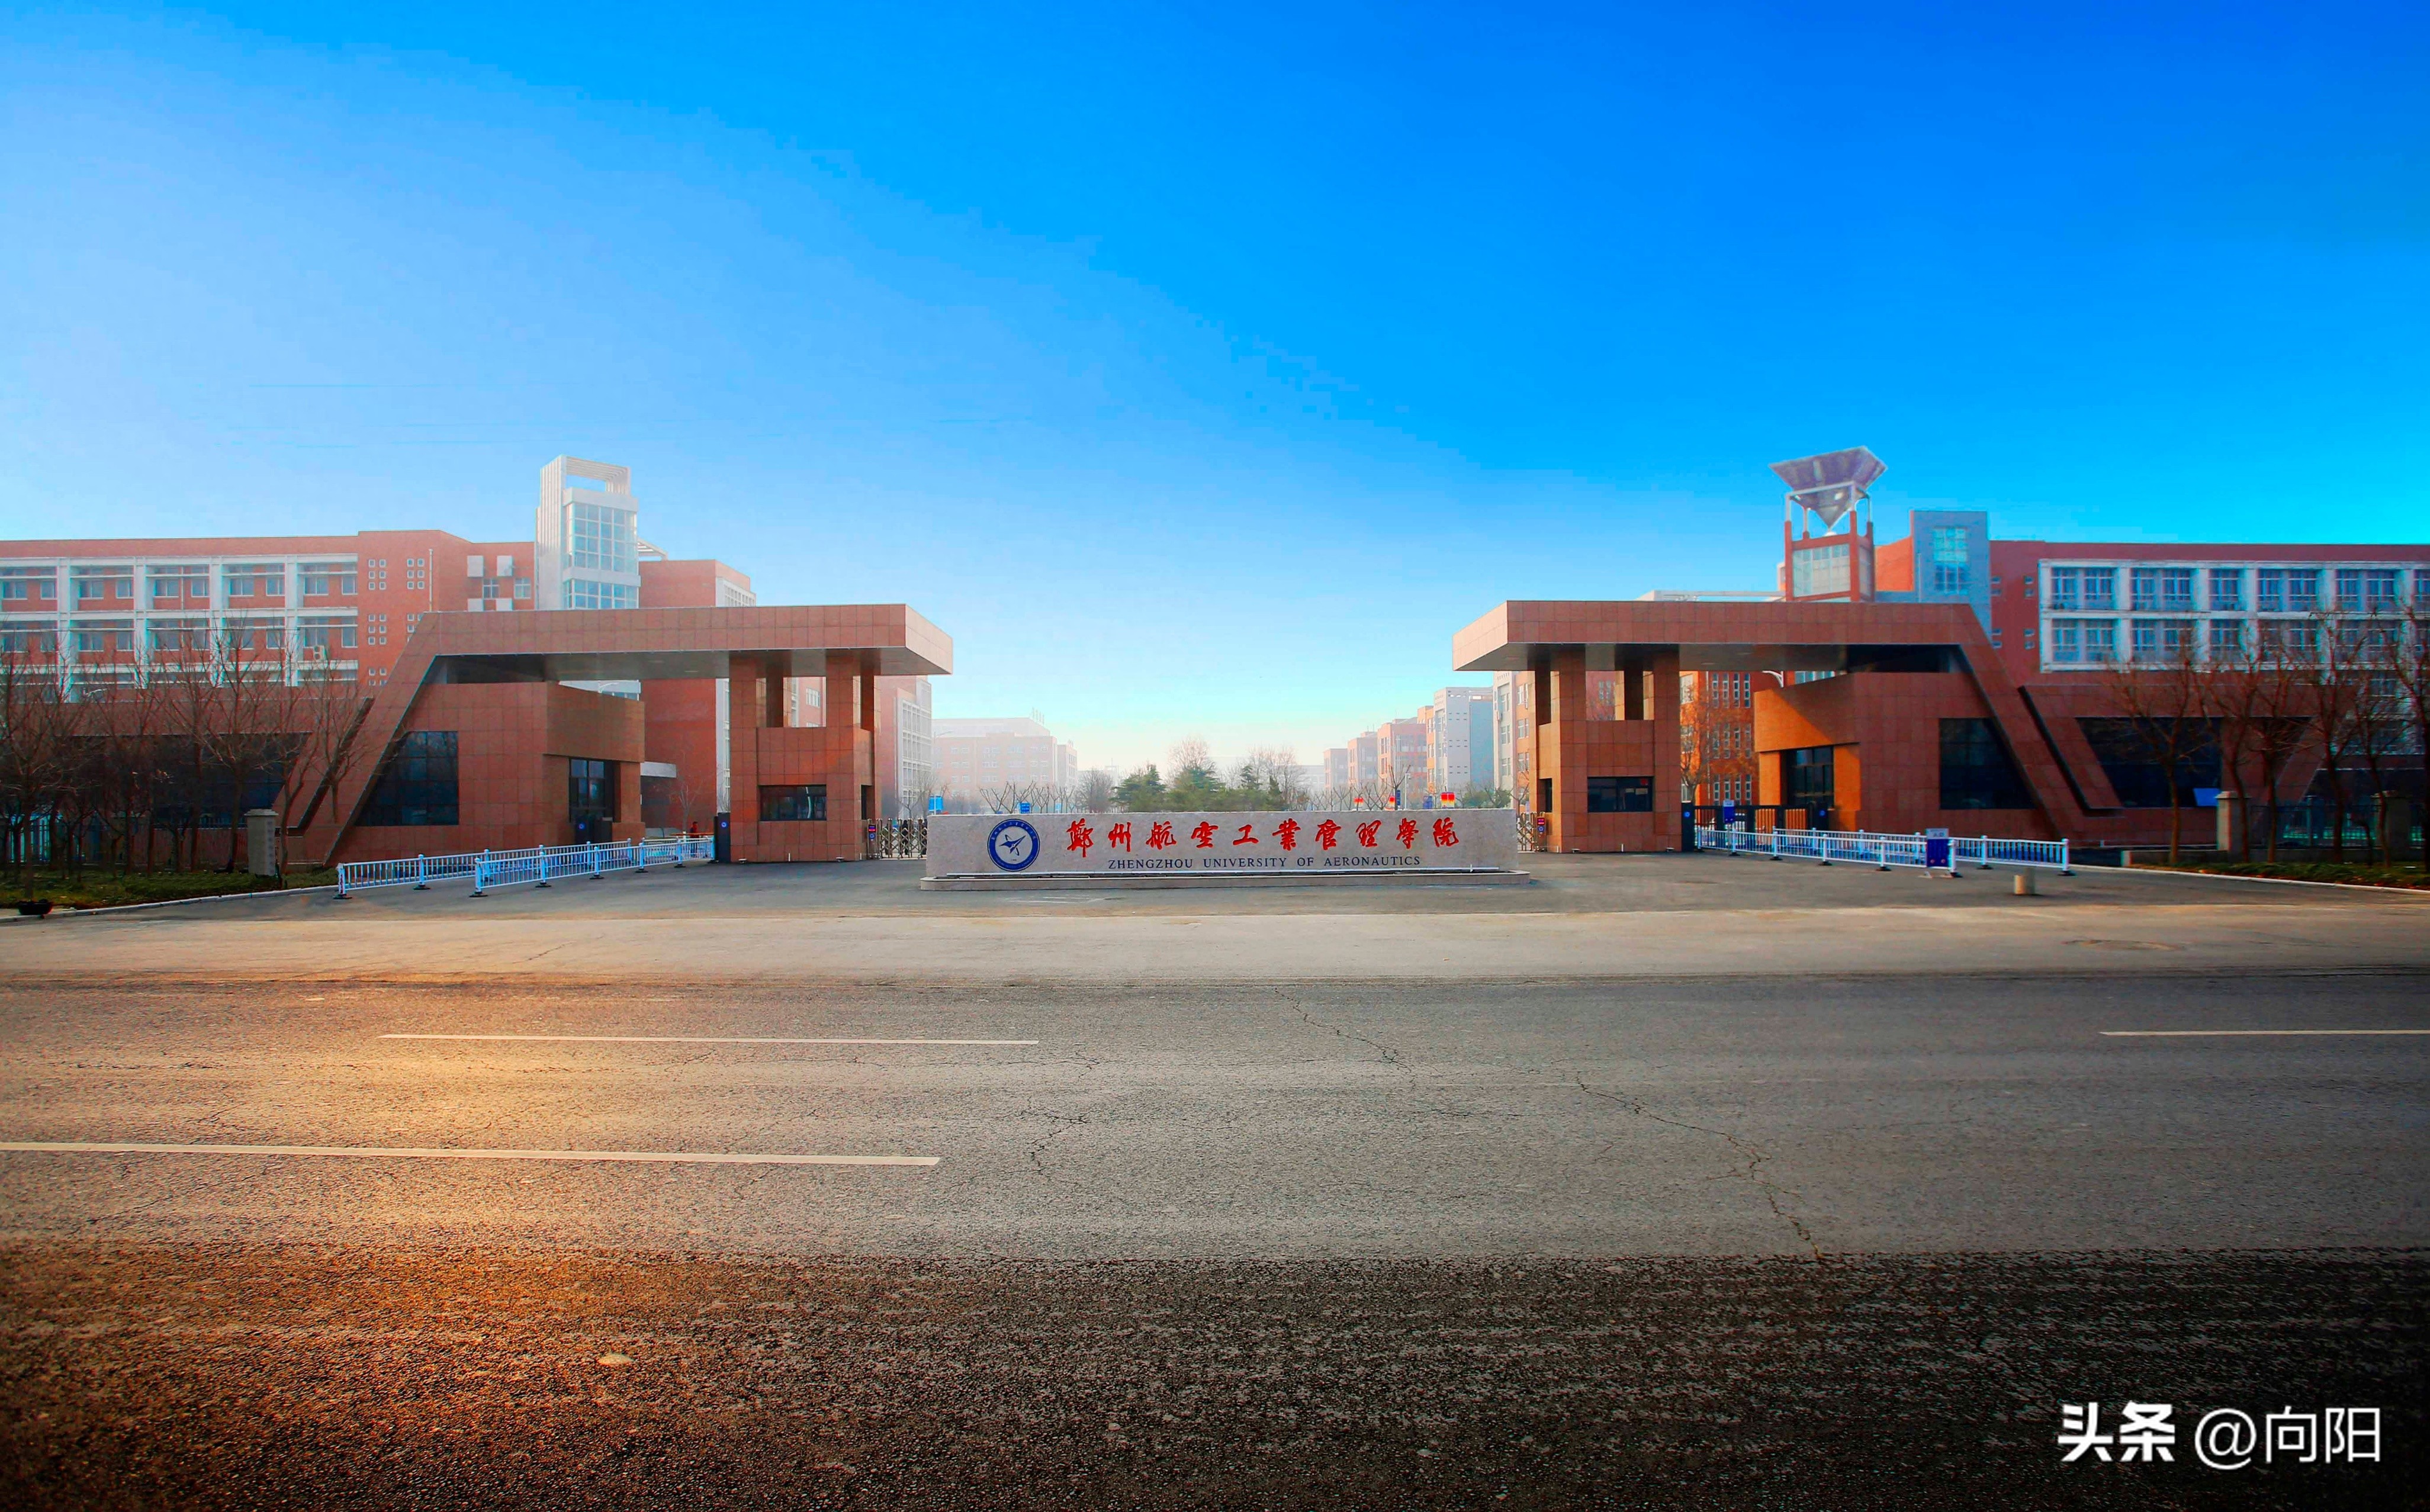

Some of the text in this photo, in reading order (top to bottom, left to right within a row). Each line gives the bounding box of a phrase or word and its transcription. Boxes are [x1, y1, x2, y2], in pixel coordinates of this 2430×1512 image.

[1108, 856, 1420, 869] ZHENGZHOU UNIVERSITY OF AERONAUTICS
